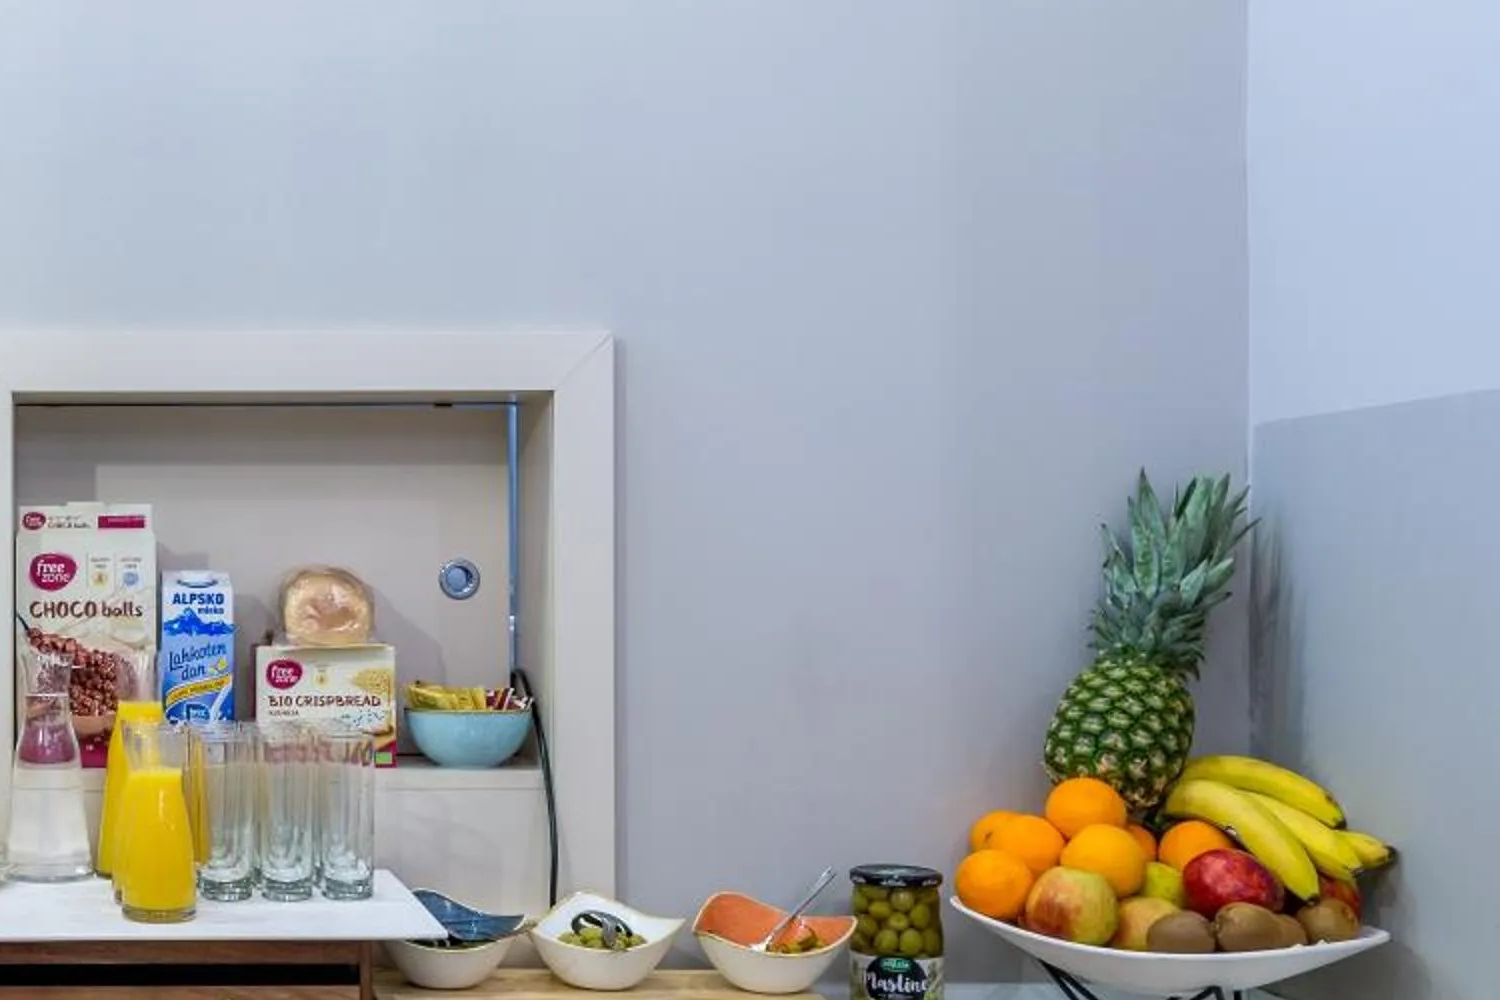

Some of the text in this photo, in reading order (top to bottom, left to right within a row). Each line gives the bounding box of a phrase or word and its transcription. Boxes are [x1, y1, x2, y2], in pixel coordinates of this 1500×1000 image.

[36, 560, 65, 577] free
[172, 593, 225, 605] ALPSKO
[29, 600, 144, 619] CHOCO balls
[181, 660, 206, 681] dan
[271, 665, 294, 679] free
[268, 695, 381, 707] BIO CRISPBREAD
